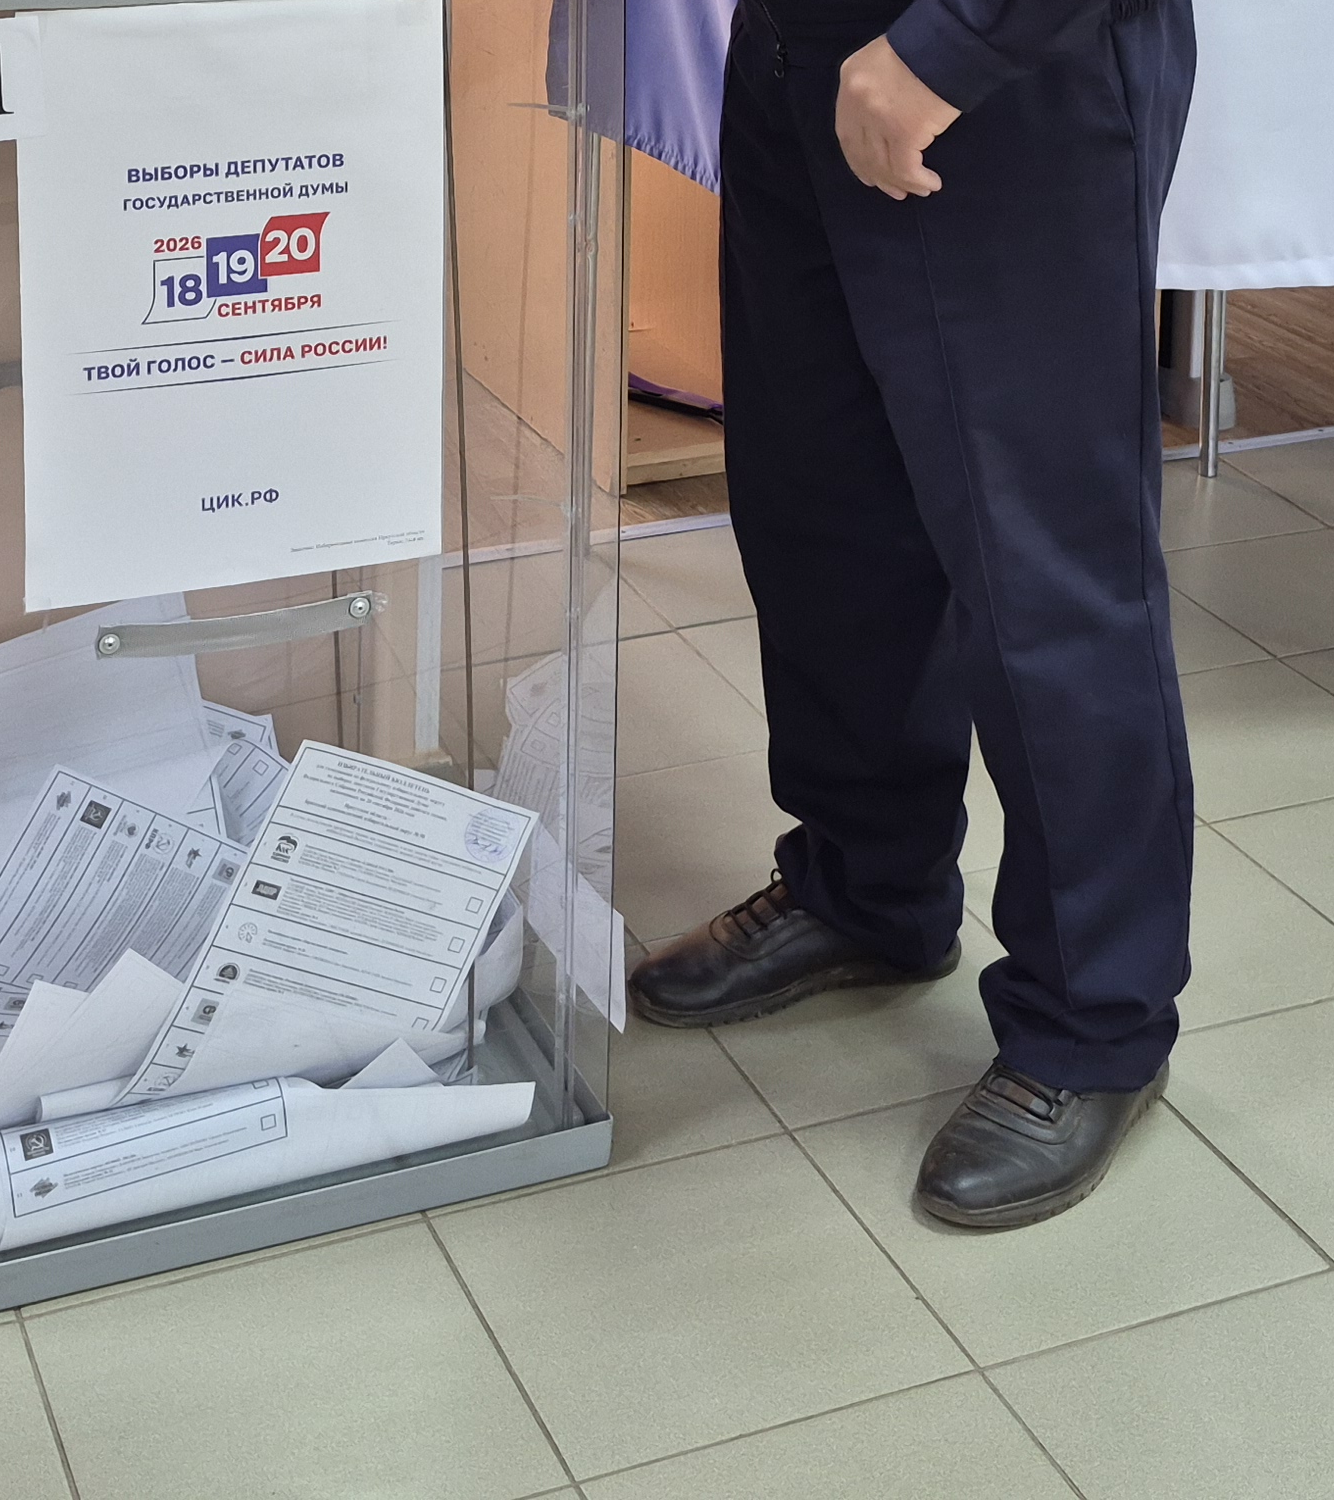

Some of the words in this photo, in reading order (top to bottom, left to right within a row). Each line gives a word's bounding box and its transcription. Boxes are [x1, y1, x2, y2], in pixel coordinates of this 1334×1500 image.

[127, 162, 219, 183] ВЫБОРЫ
[225, 153, 345, 178] ДЕПУТАТОВ
[123, 182, 294, 211] ГОСУДАРСТВЕННОЙ
[298, 181, 348, 199] ДУМЫ
[153, 235, 202, 253] 2026
[160, 273, 204, 308] 18
[212, 249, 255, 284] 19
[265, 227, 316, 264] 20
[217, 293, 322, 318] СЕНТЯБРЯ
[83, 358, 140, 381] ТВОЙ
[147, 354, 215, 375] ГОЛОС
[240, 345, 295, 365] СИЛА
[301, 335, 388, 359] РОССИИ!
[201, 488, 279, 513] ЦИК.РФ
